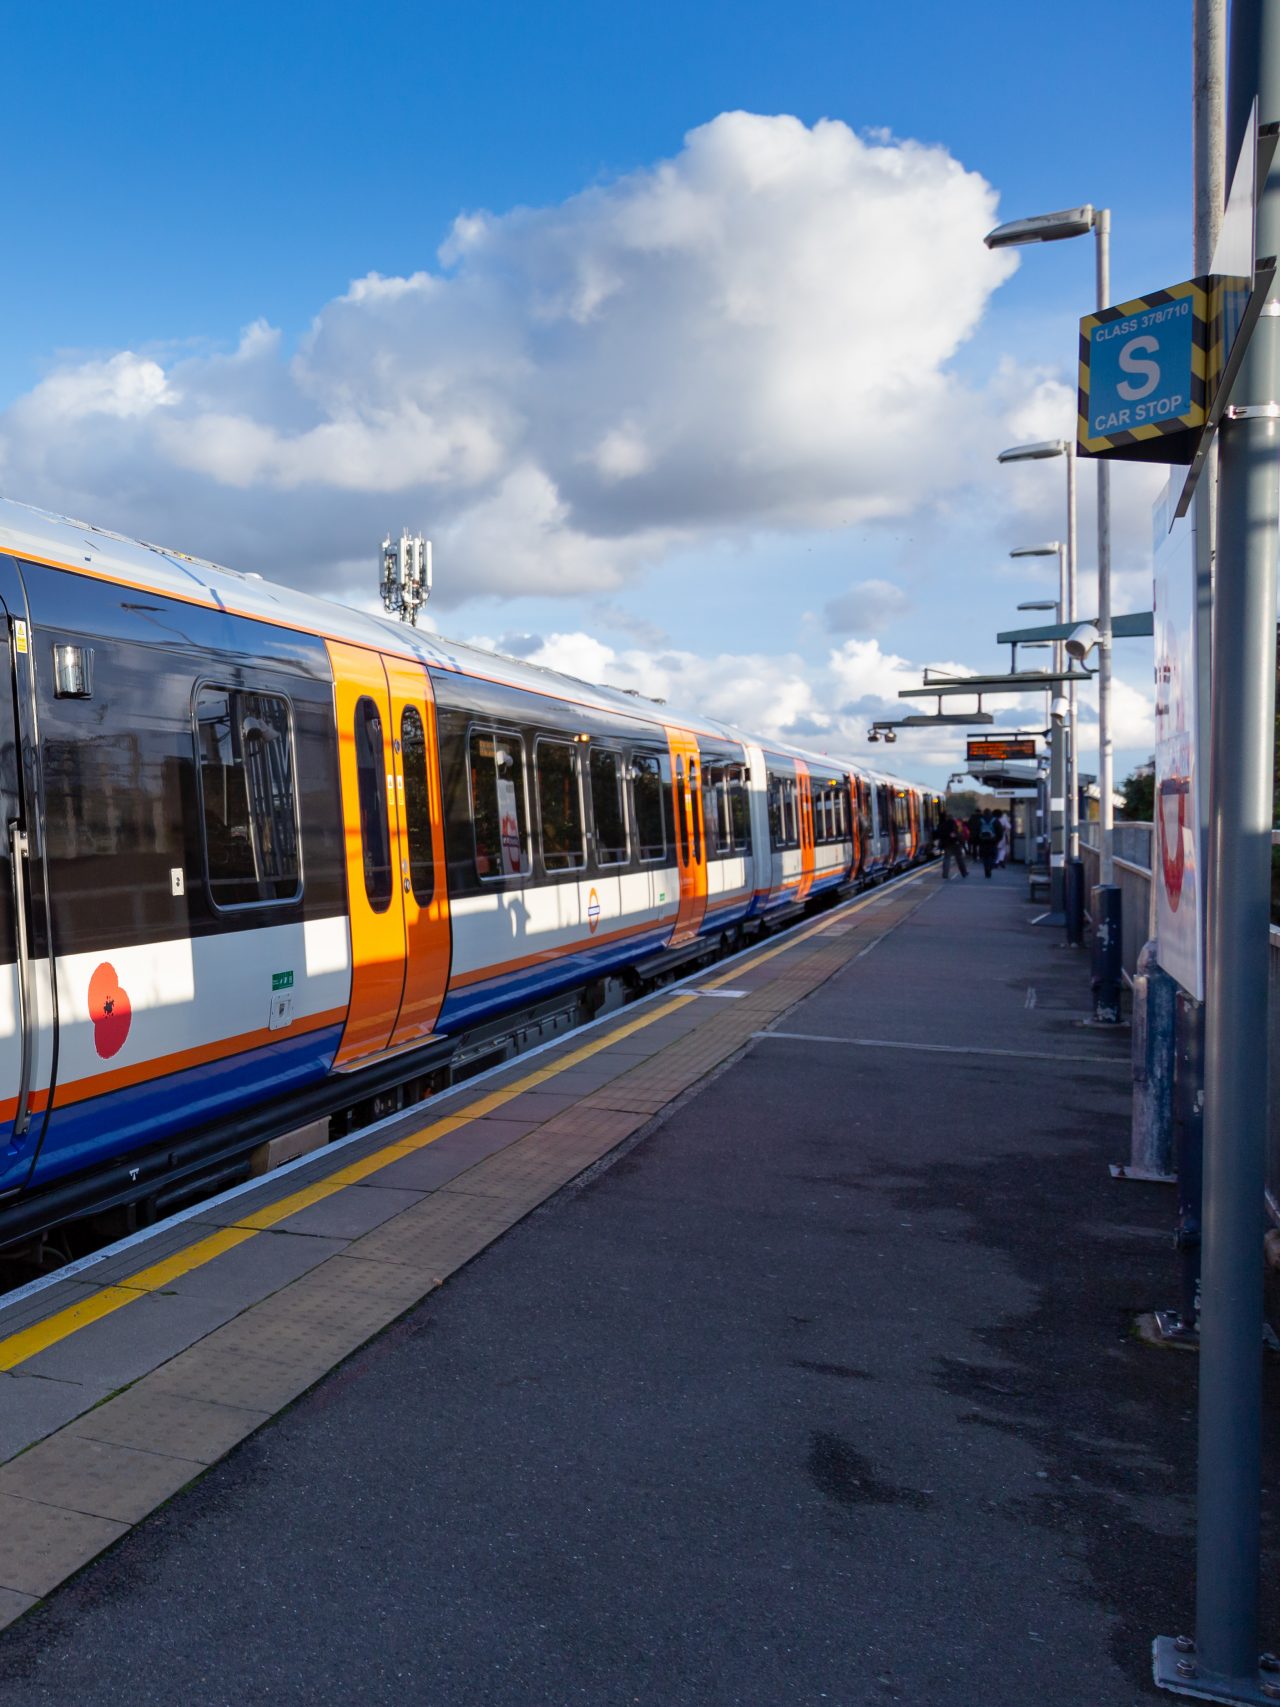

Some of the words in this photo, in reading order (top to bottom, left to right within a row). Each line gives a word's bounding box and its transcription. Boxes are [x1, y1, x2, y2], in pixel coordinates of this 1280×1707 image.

[1096, 319, 1137, 342] CLASS
[1141, 302, 1189, 328] 378/710
[1115, 334, 1160, 401] S
[1095, 410, 1131, 431] CAR
[1135, 395, 1182, 420] STOP
